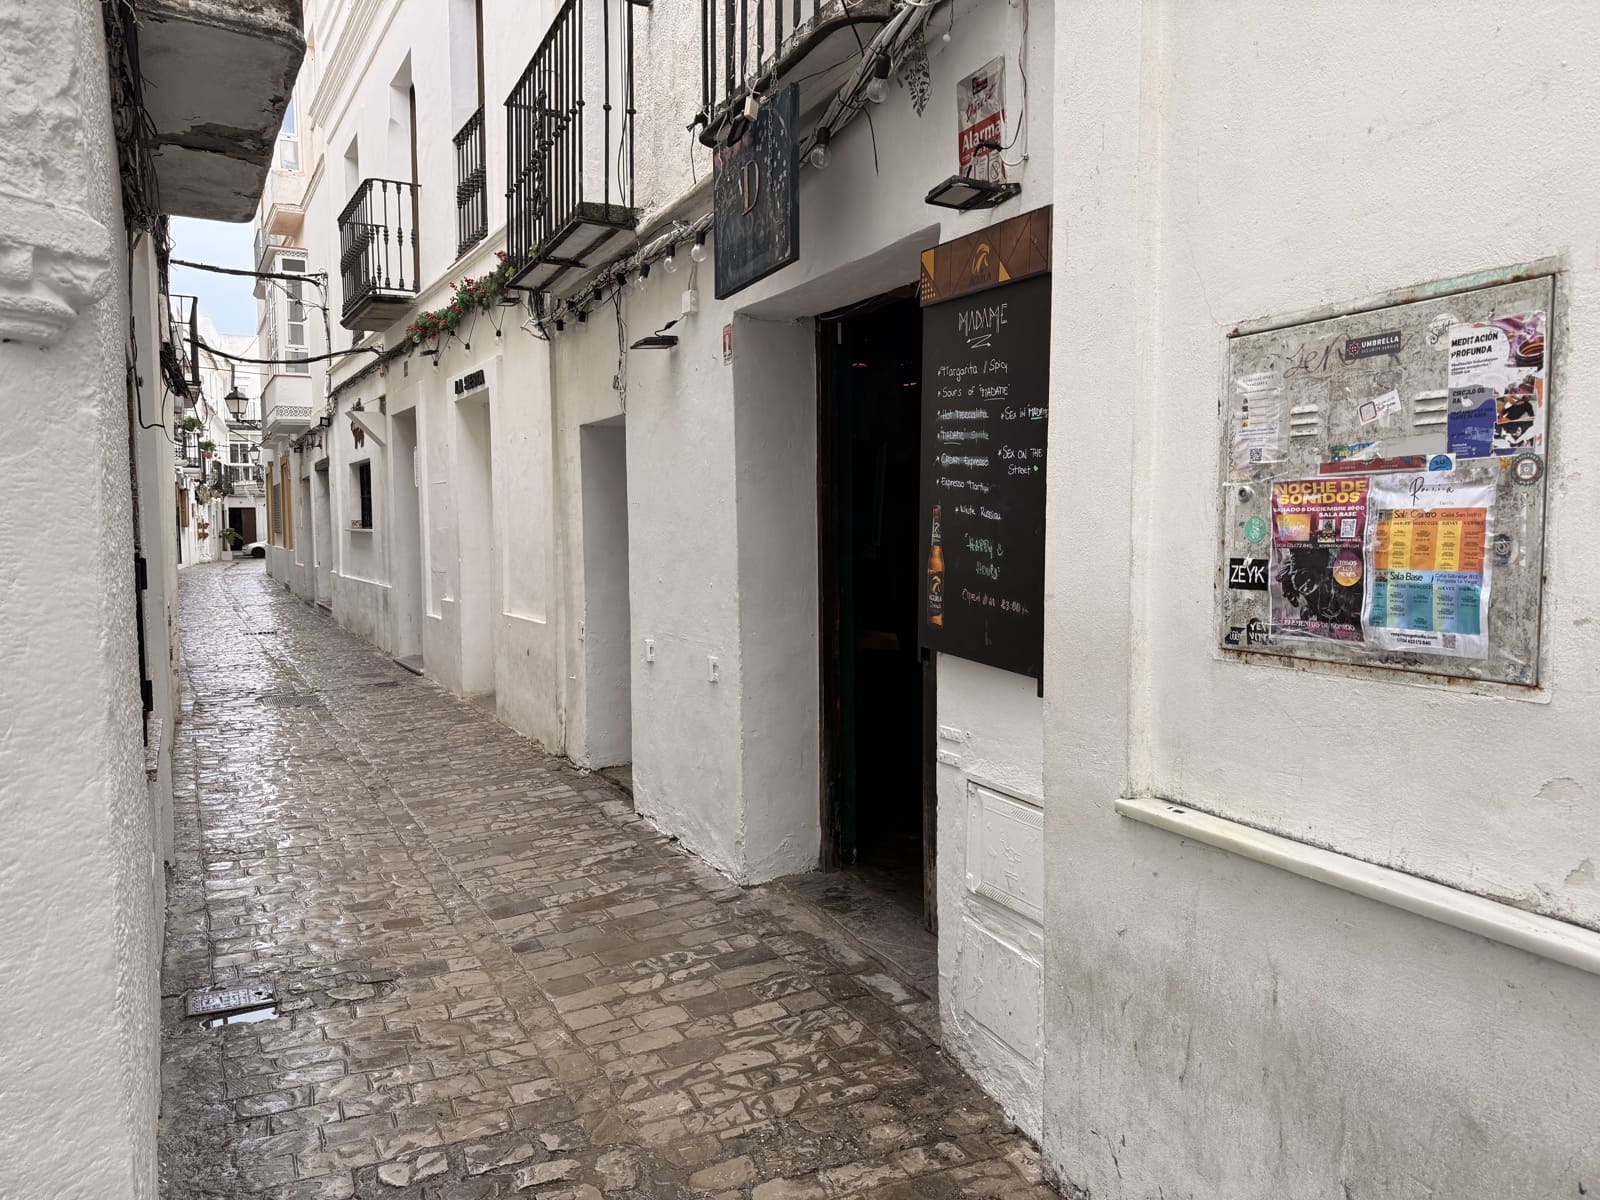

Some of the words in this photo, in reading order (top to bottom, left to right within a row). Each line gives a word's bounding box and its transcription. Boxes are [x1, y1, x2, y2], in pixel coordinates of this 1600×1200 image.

[962, 120, 1001, 153] Alarma
[958, 303, 1009, 336] MADAME
[1361, 334, 1400, 349] UMBRELLA
[1451, 331, 1499, 348] MEDITACIÓN
[1451, 344, 1493, 359] PROFUNDA
[1274, 482, 1338, 496] NOCHE
[1340, 480, 1369, 493] DE
[1278, 491, 1361, 506] SONIDOS
[1230, 564, 1266, 584] ZEYK
[1390, 571, 1405, 581] Sala
[1405, 571, 1424, 582] Base
